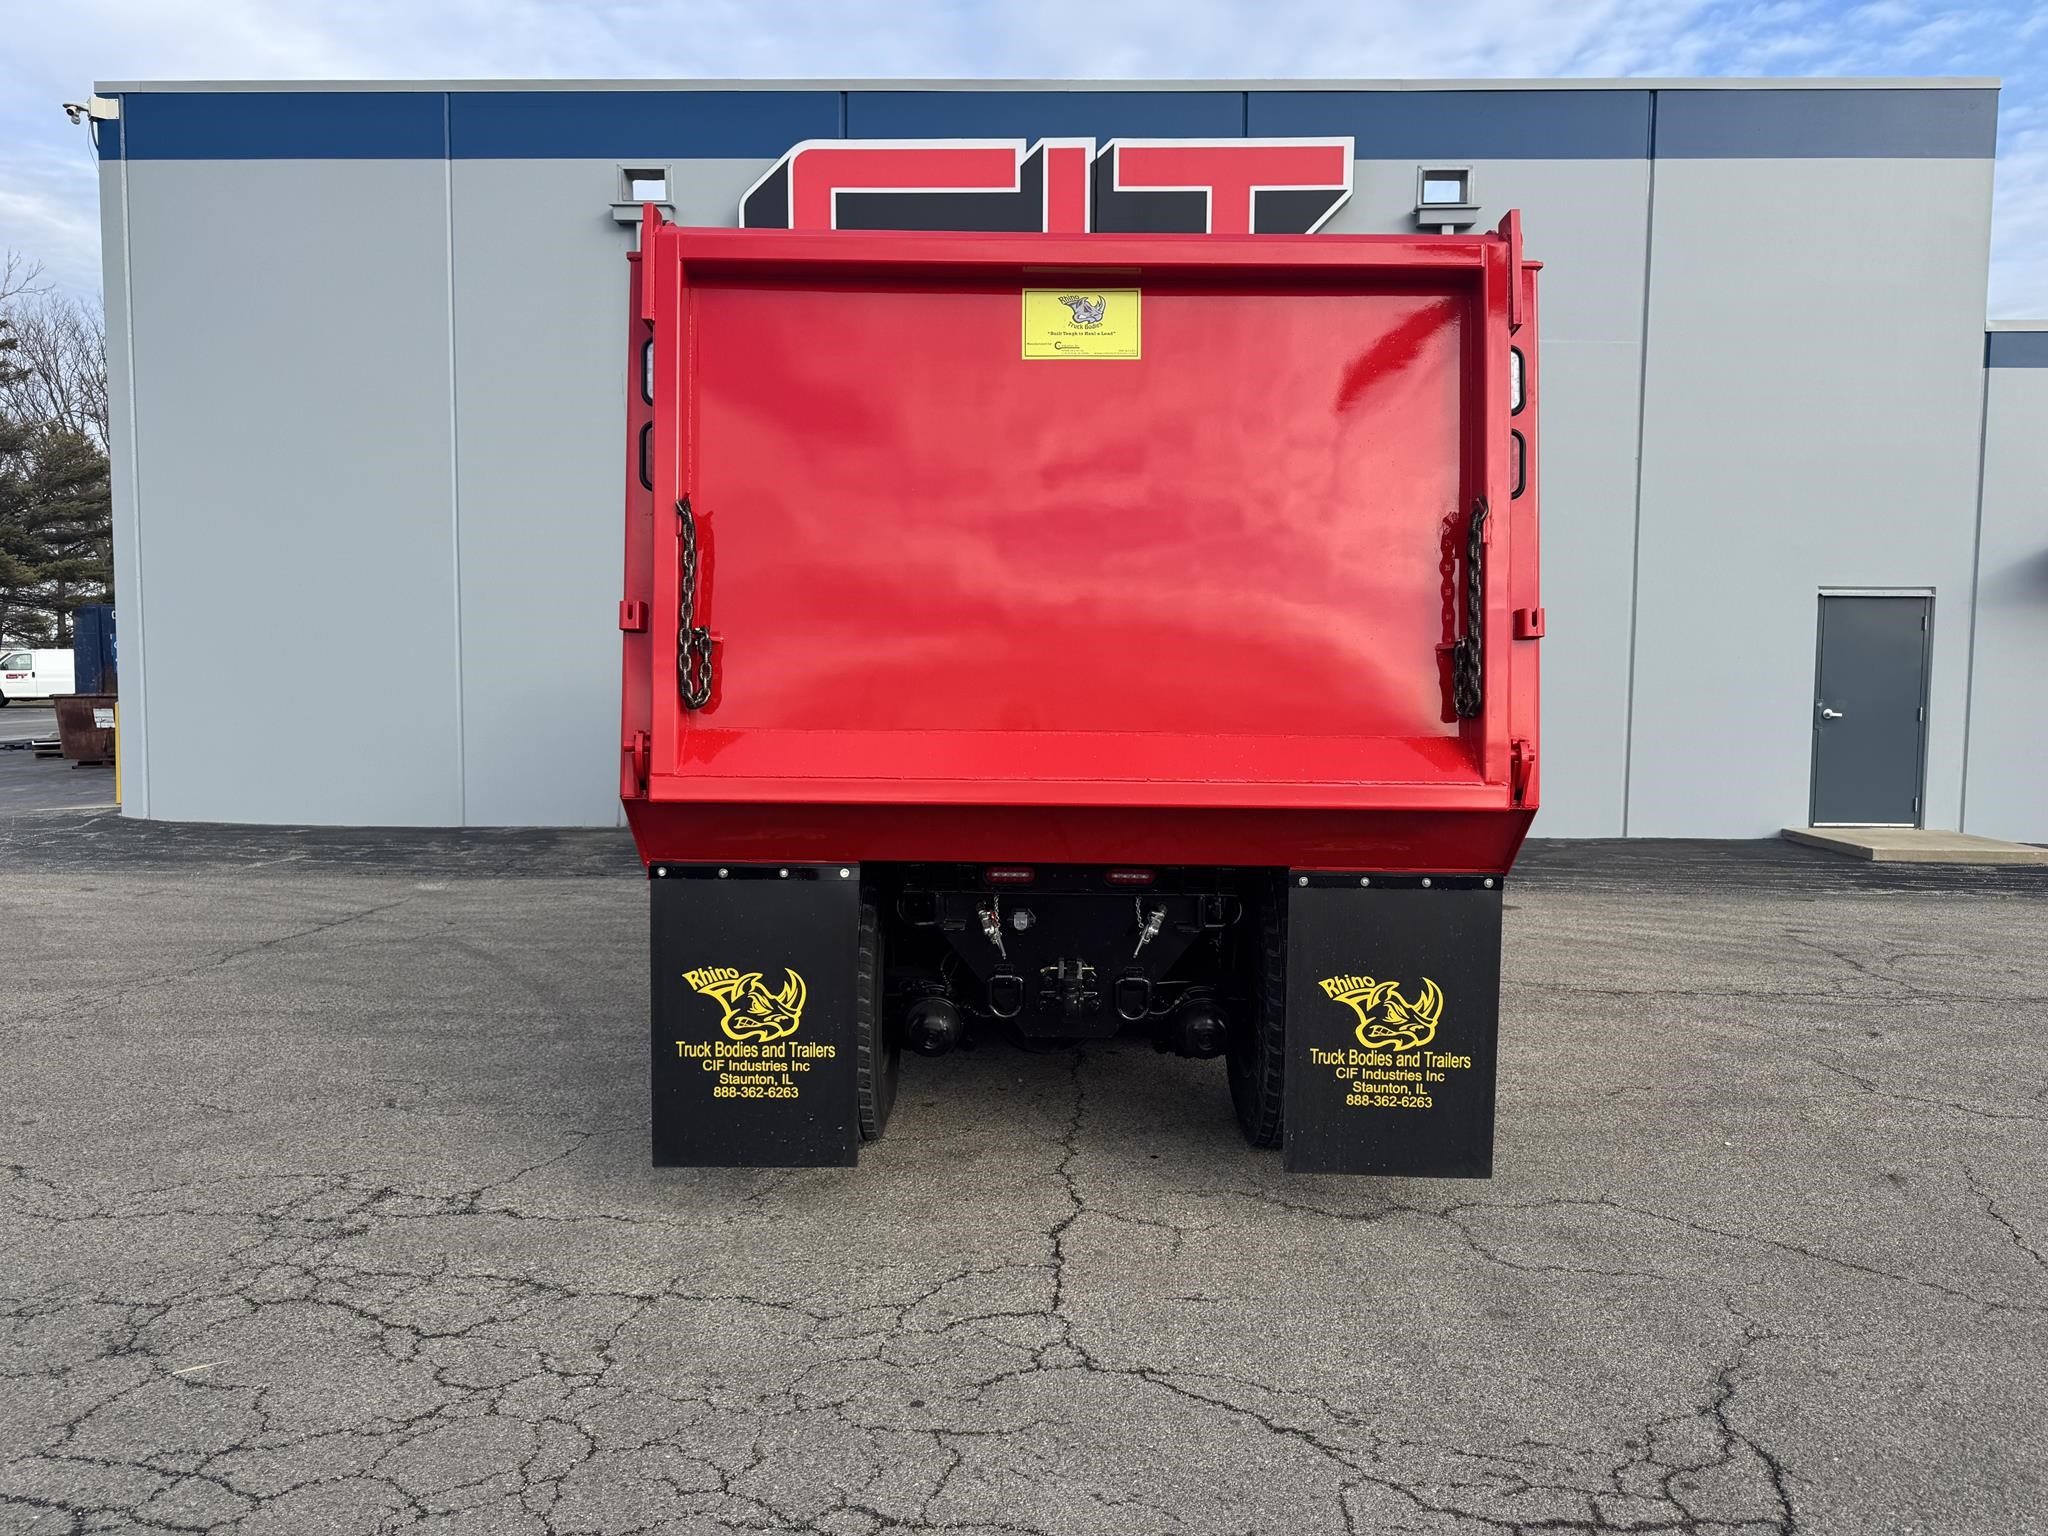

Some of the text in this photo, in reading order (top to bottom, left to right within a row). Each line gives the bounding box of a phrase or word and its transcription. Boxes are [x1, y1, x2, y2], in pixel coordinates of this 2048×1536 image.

[1057, 294, 1080, 304] Rhino
[1067, 321, 1103, 330] Truck Bodies
[682, 966, 739, 991] Rhino
[1318, 974, 1376, 999] Rhino
[675, 1041, 836, 1059] Truck Bodies and Trailers
[702, 1059, 811, 1072] CIF Industries Inc
[1310, 1048, 1472, 1069] Truck Bodies and Trailers
[719, 1073, 794, 1086] Staunton, IL
[1335, 1067, 1445, 1082] CIF Industries Inc
[713, 1086, 799, 1098] 888-362-6263
[1352, 1082, 1428, 1096] Staunton, IL
[1346, 1094, 1433, 1108] 888-362-6263
